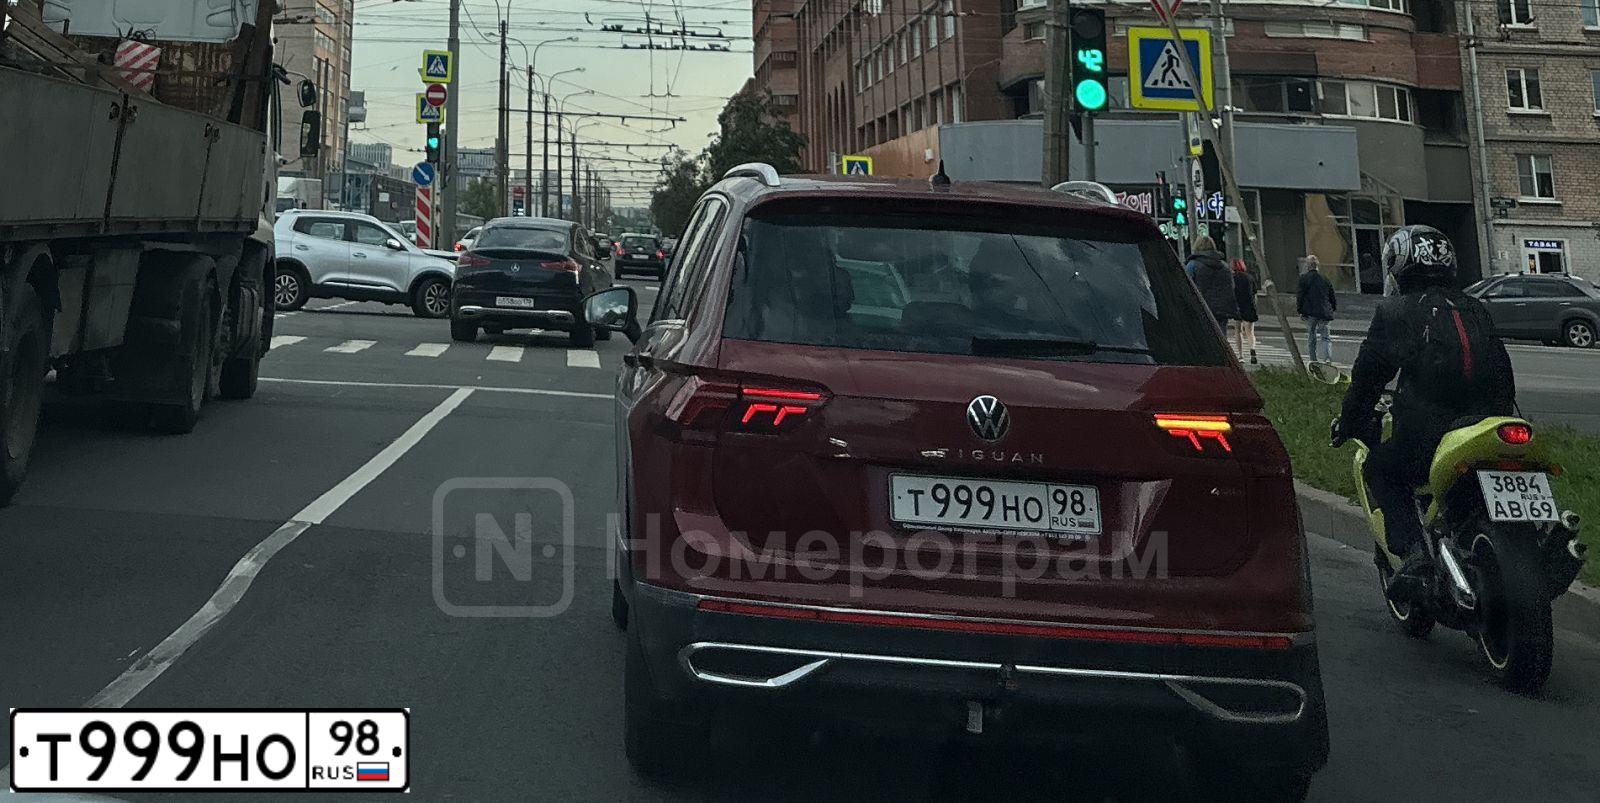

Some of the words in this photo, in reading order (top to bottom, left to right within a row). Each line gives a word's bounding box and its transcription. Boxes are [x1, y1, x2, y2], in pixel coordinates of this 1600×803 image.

[1078, 49, 1103, 72] 42
[1489, 472, 1542, 493] 3884
[1052, 488, 1086, 516] 98
[1530, 502, 1553, 518] 69
[1051, 516, 1077, 528] RUS
